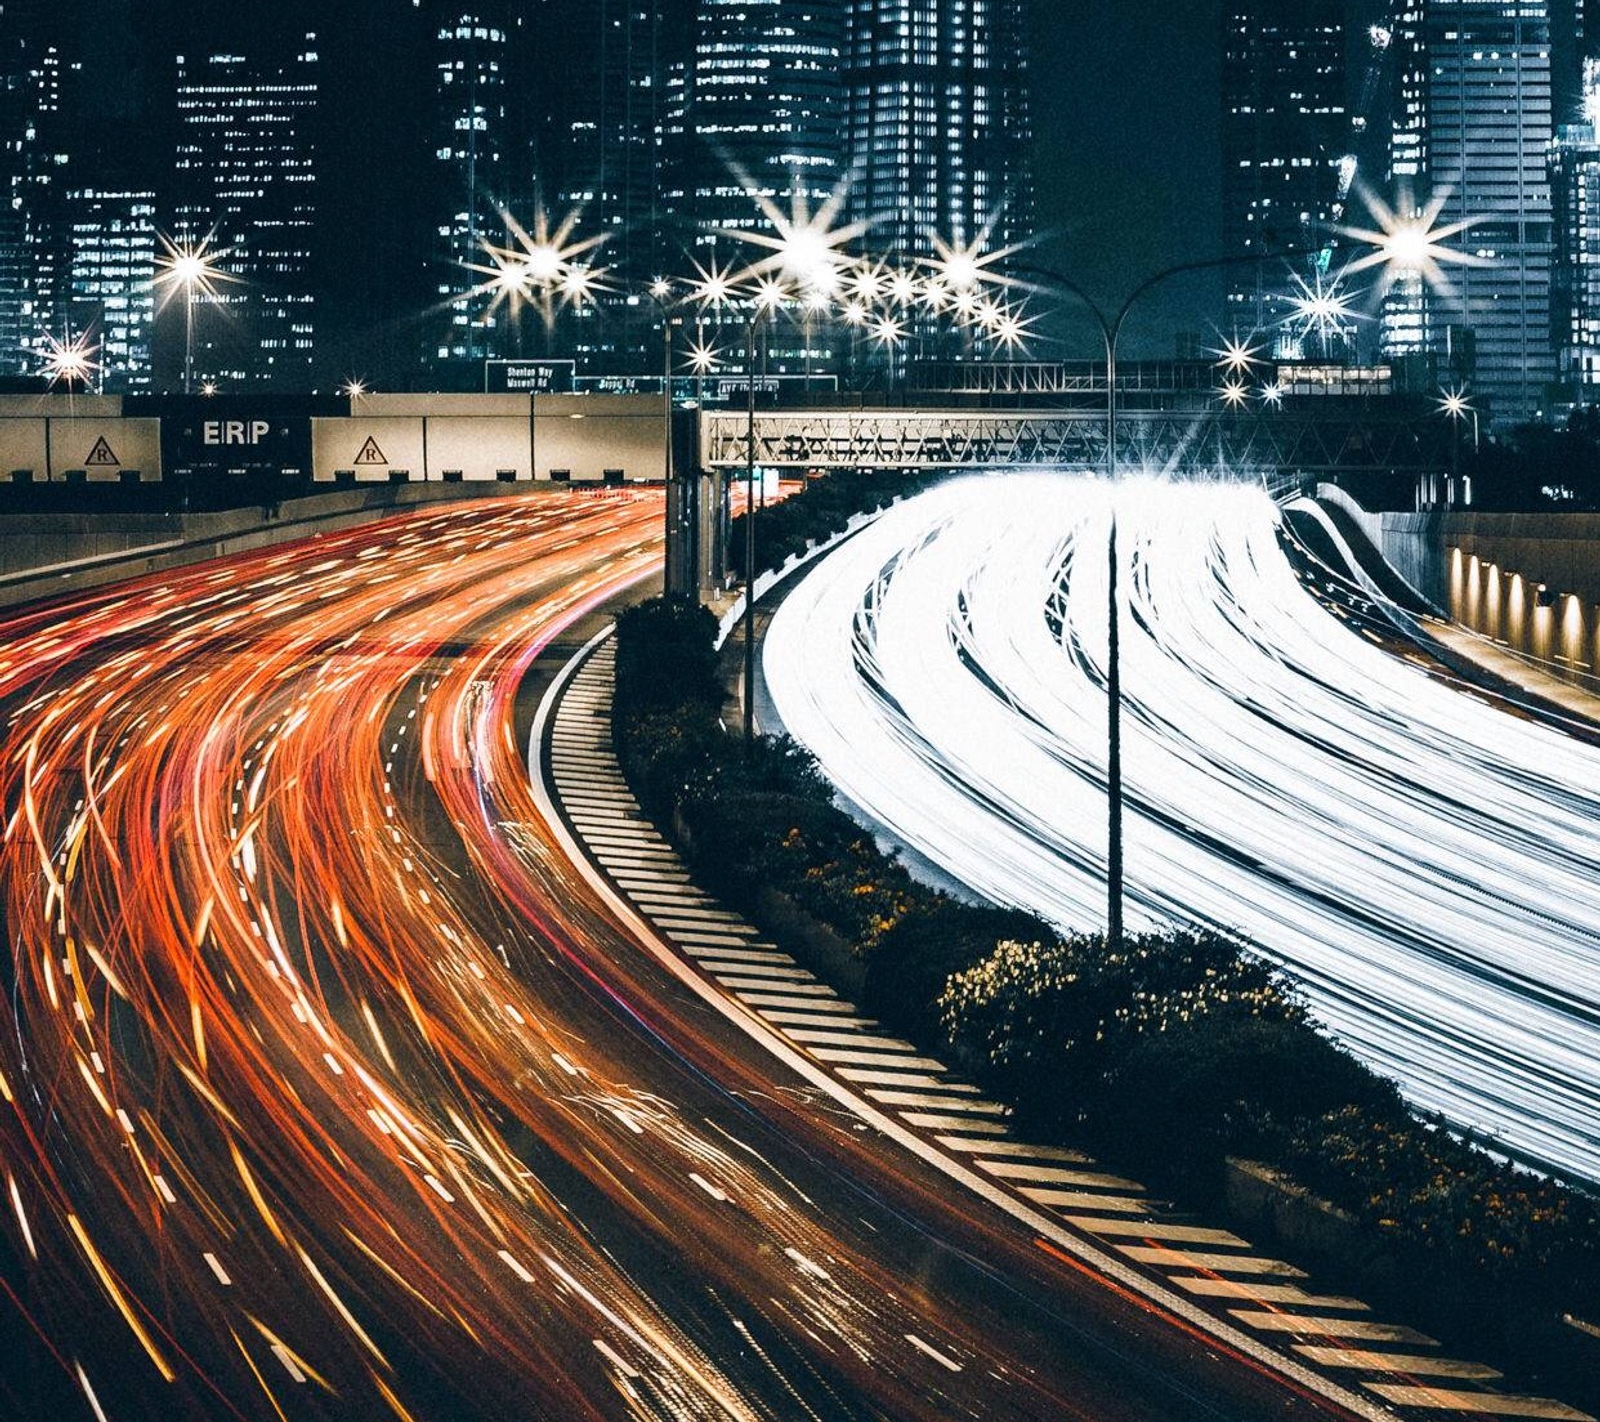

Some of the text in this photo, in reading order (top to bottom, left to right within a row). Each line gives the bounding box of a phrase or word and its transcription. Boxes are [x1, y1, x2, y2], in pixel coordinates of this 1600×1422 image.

[507, 366, 553, 379] Shenton Way
[537, 378, 548, 388] Rd
[203, 420, 270, 445] ERP
[97, 448, 108, 461] R
[365, 448, 376, 461] R
